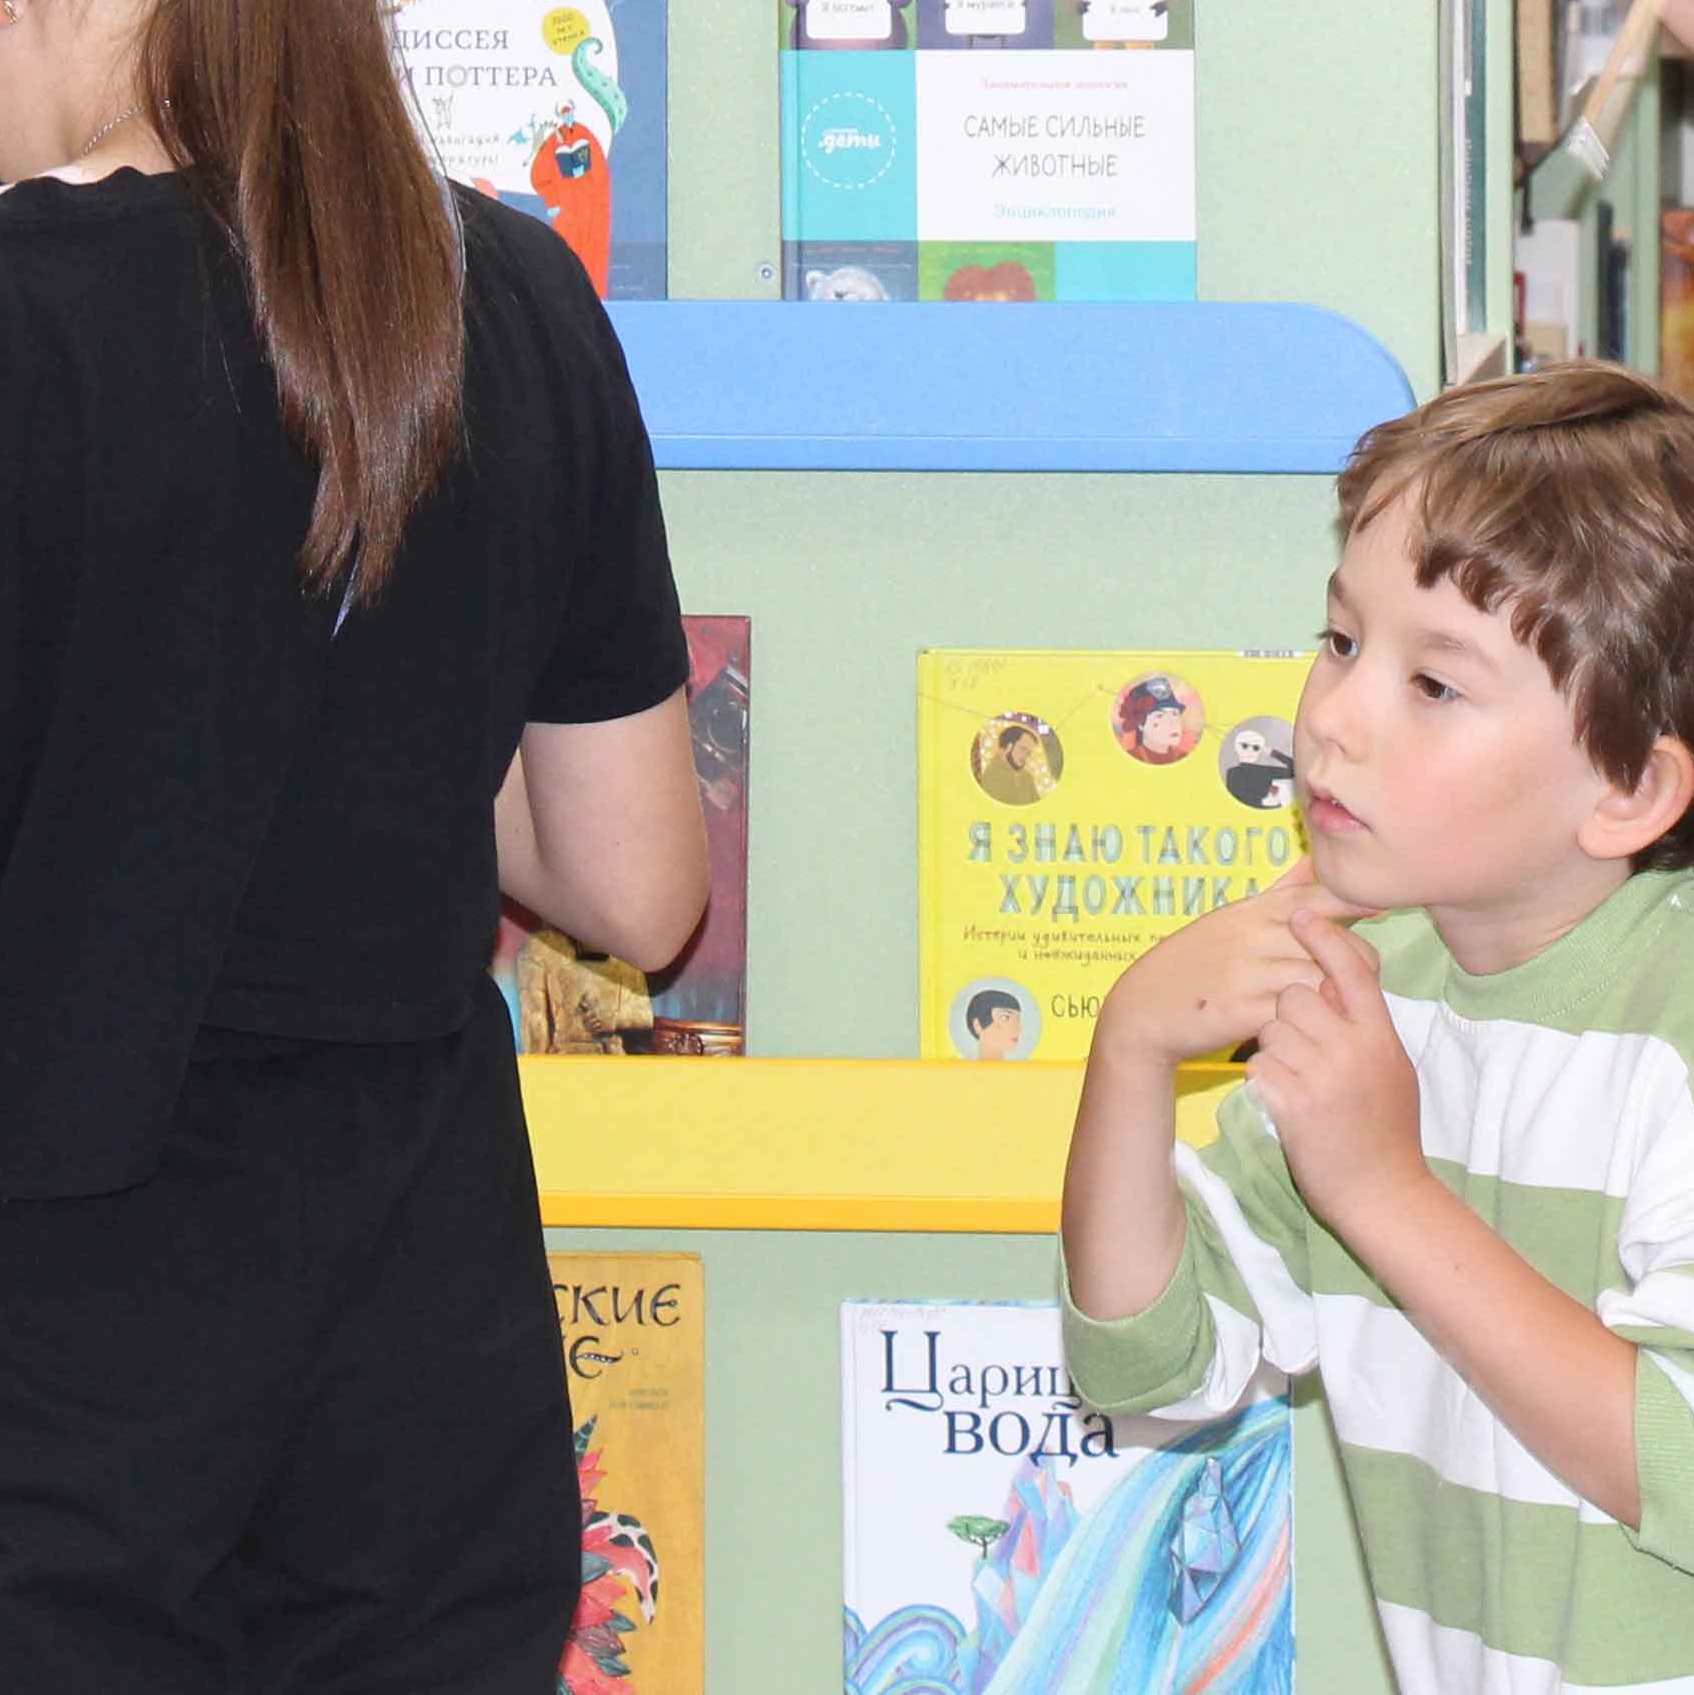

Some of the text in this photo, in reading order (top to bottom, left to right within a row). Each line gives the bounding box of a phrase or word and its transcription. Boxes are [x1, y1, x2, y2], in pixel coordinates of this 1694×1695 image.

[425, 64, 557, 87] ПОТТЕРА
[964, 114, 1146, 138] САМЫЕ СИЛЬНЫЕ
[991, 154, 1118, 178] ЖИВОТНЫЕ
[967, 822, 1291, 867] Я ЗНАЮ ТАКОГО
[1051, 994, 1106, 1019] СЬЮ
[563, 1335, 623, 1379] Е
[943, 1410, 1120, 1468] вода
